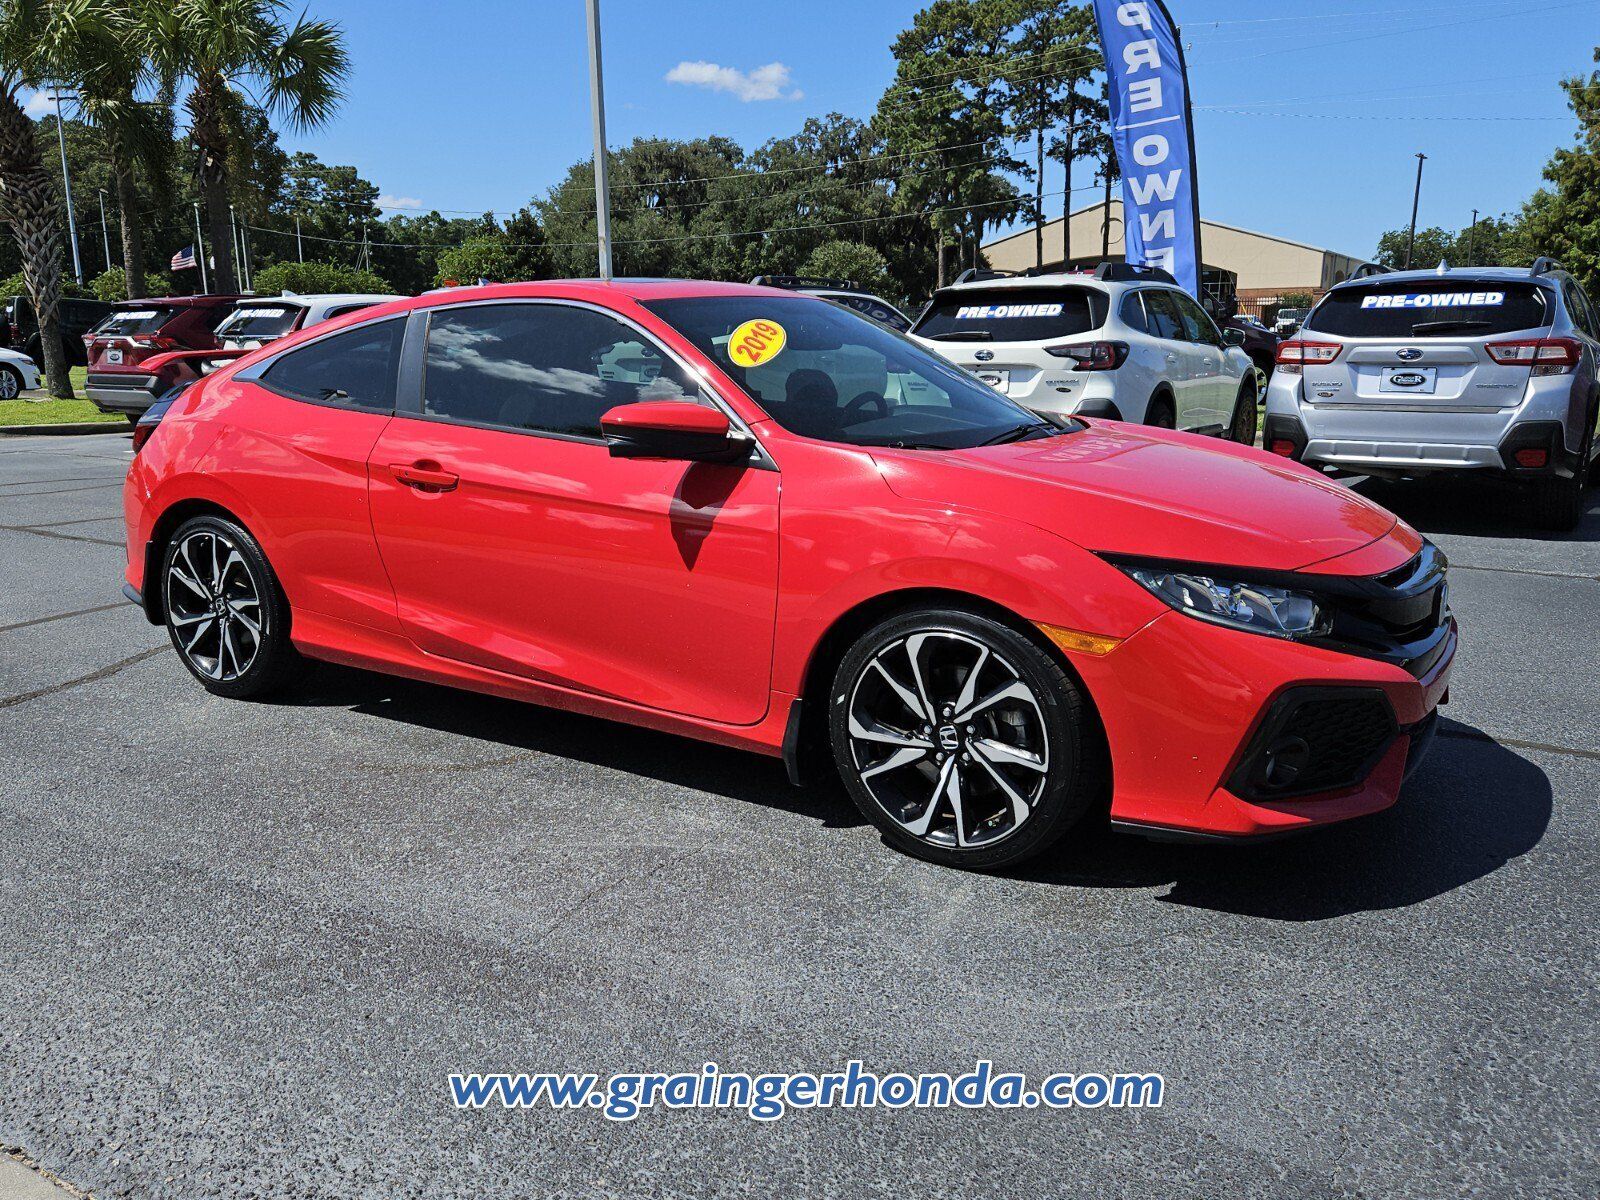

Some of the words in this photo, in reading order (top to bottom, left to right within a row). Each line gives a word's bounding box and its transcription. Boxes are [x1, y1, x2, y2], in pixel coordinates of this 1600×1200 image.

[1360, 292, 1504, 309] PRE-OWNED
[955, 303, 1063, 319] PRE-OWNED
[736, 322, 778, 363] 2019
